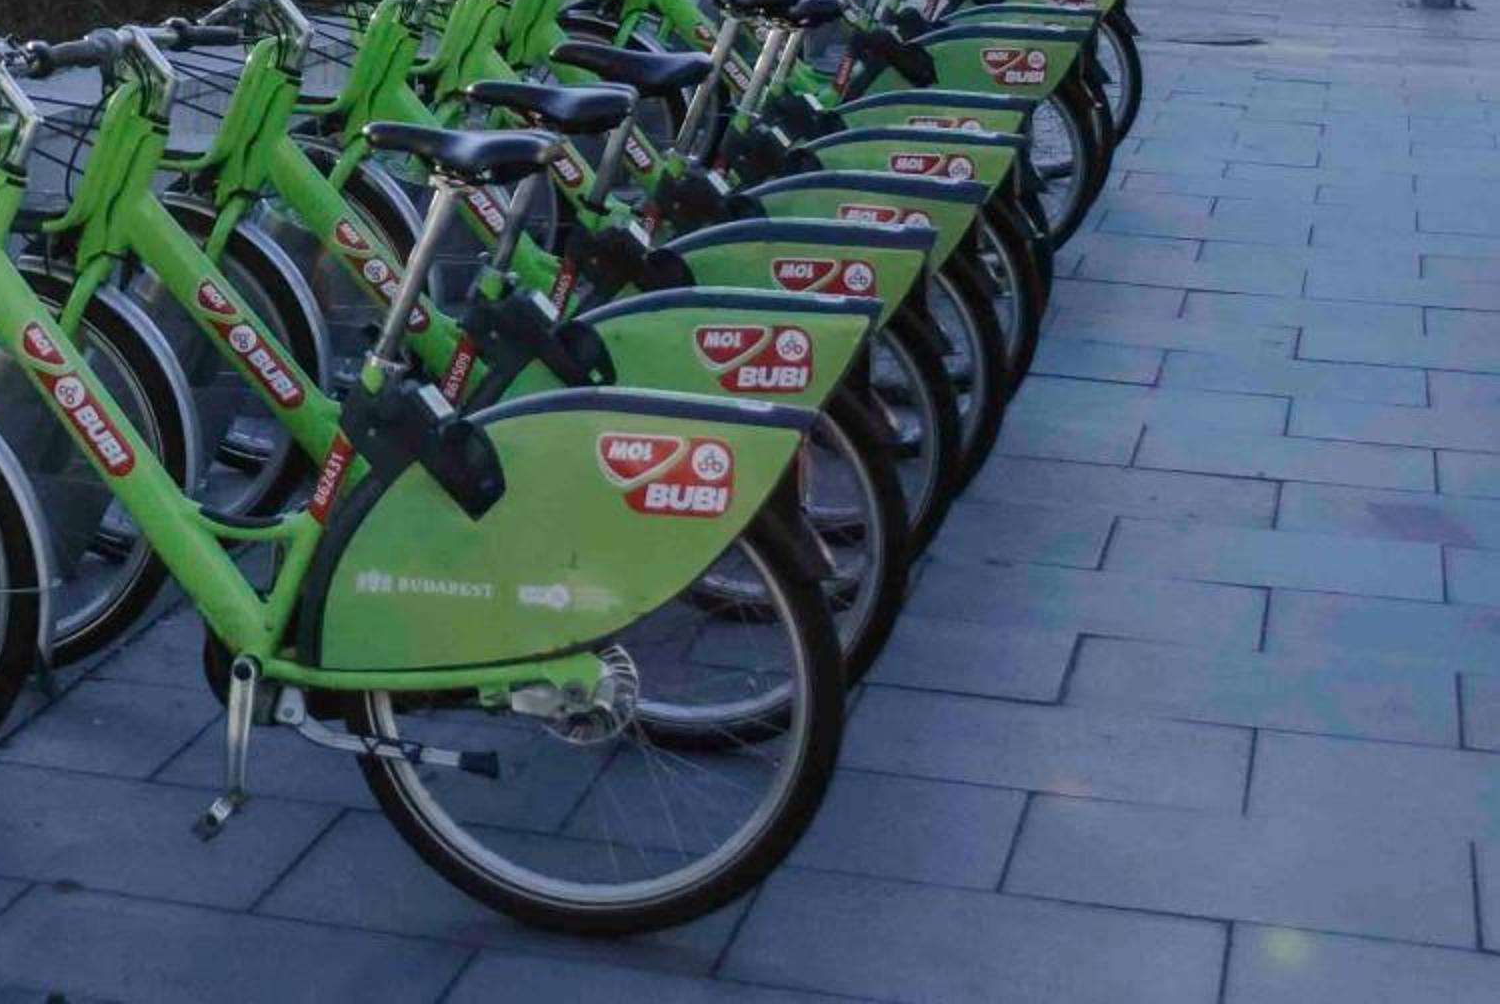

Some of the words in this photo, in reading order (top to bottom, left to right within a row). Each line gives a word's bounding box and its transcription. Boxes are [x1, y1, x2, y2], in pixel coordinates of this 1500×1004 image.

[779, 263, 814, 279] MOL
[703, 331, 742, 348] MOL
[247, 349, 299, 401] BUBI
[737, 367, 809, 388] BUBI
[73, 404, 129, 467] BUBI
[608, 439, 653, 461] MOL
[644, 483, 728, 511] BUBI
